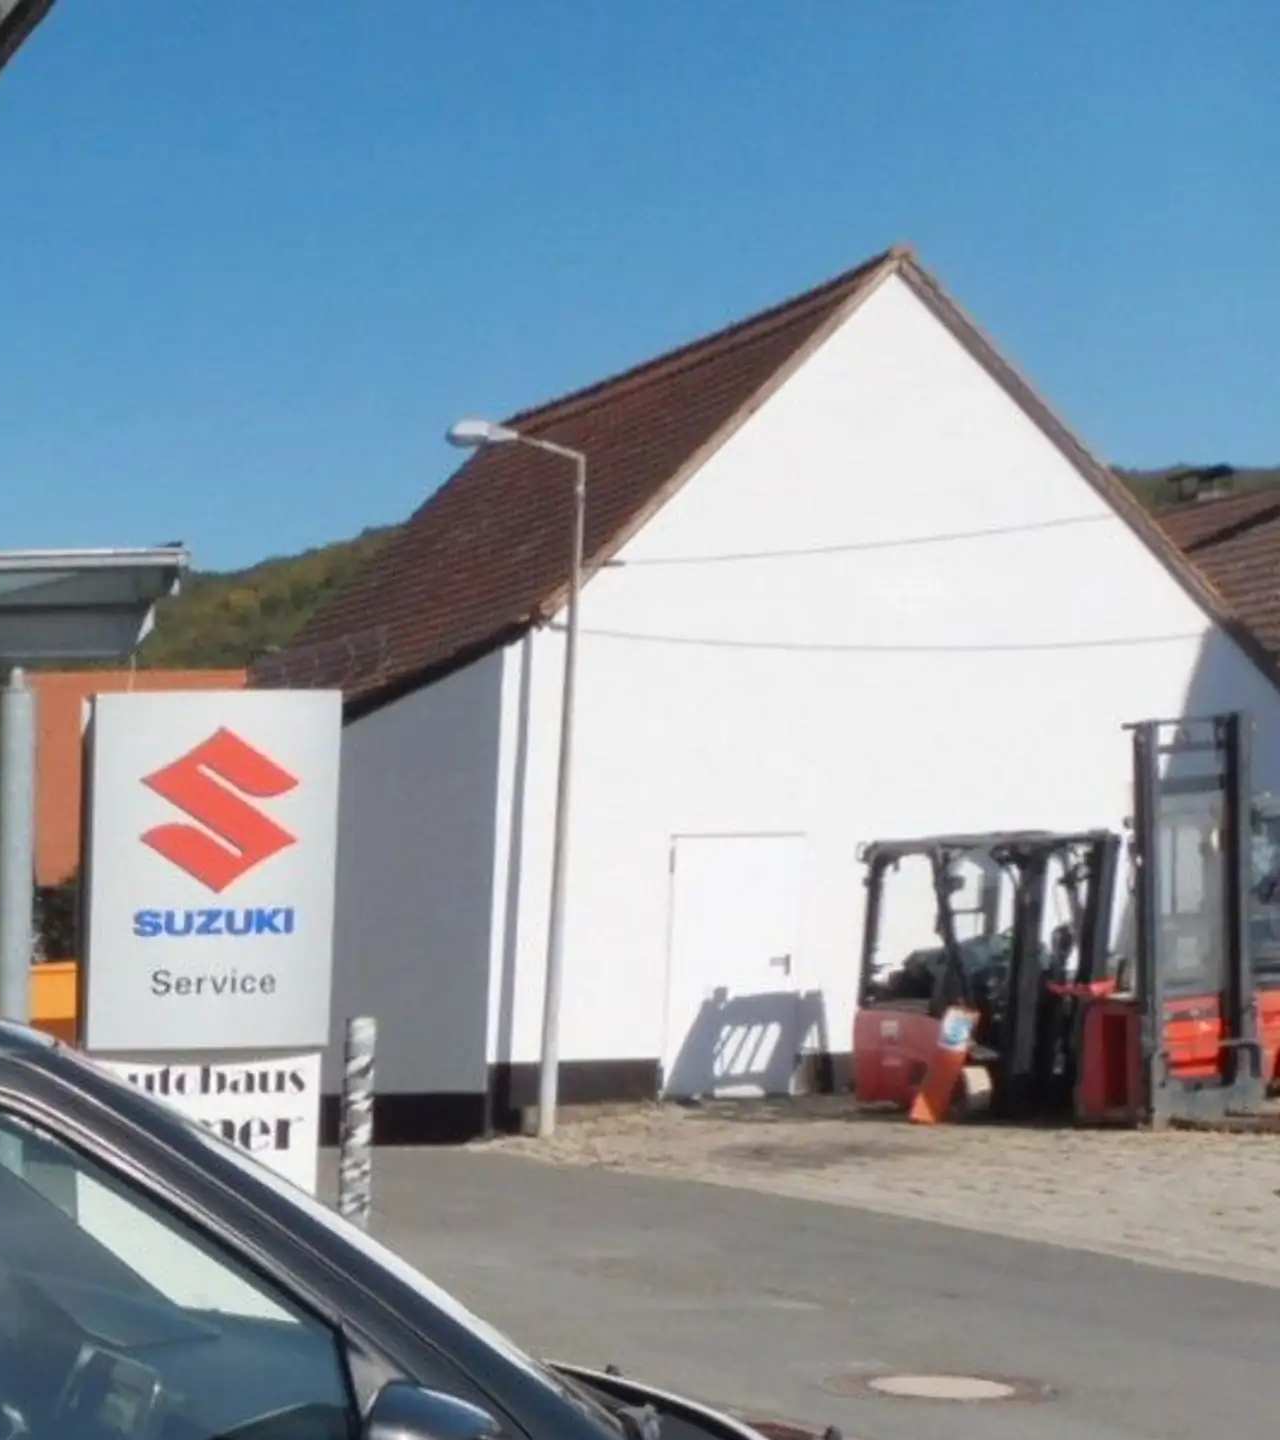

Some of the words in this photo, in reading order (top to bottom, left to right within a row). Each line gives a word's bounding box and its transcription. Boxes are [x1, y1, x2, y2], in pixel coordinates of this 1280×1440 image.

[133, 907, 294, 937] SUZUKI
[151, 970, 277, 997] Service
[126, 1066, 305, 1096] utohaus
